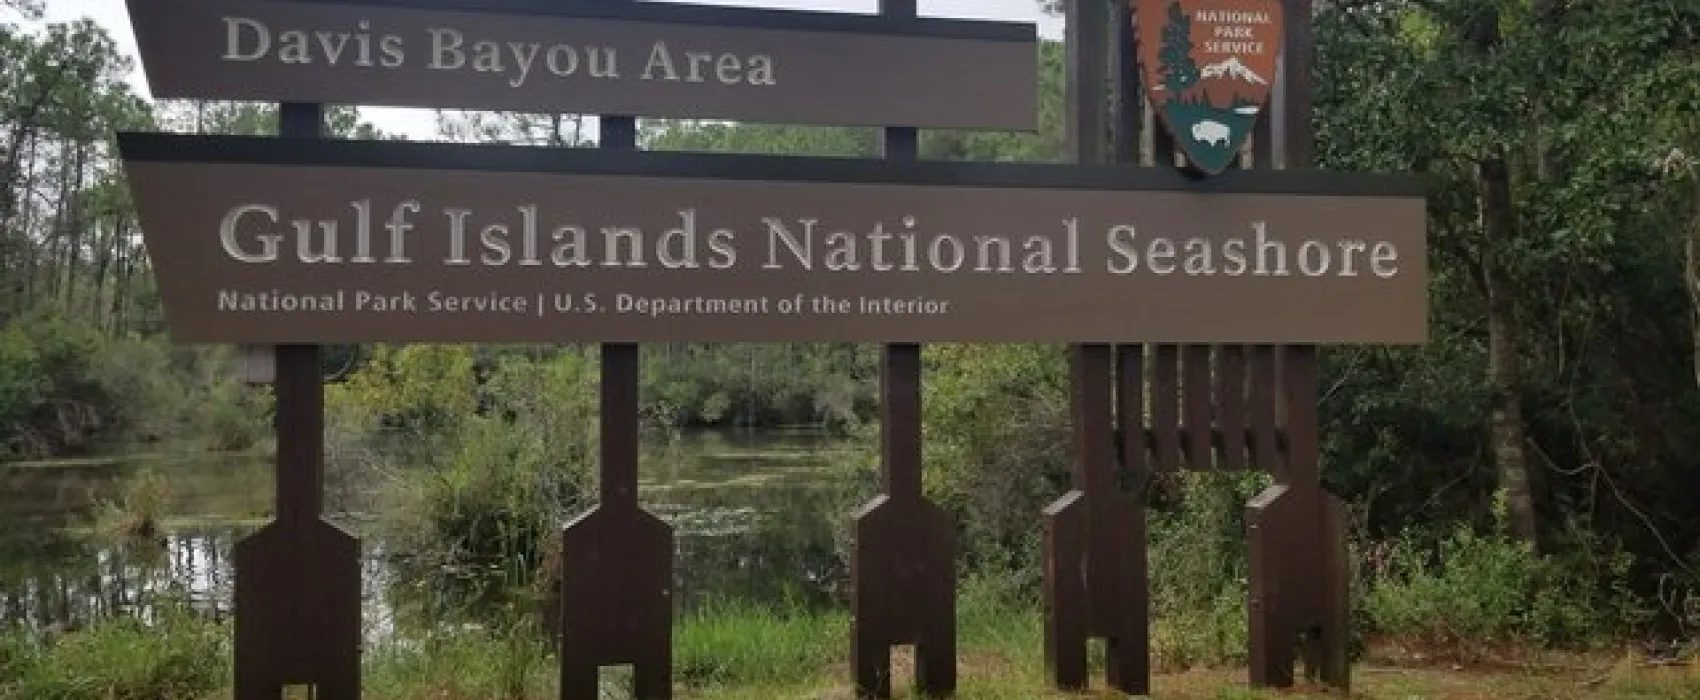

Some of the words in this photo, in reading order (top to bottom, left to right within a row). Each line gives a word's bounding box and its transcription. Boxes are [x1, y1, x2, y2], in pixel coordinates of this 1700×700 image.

[1195, 9, 1272, 23] NATIONAL
[1214, 25, 1254, 38] PARK
[219, 17, 404, 68] Davis
[426, 28, 619, 89] Bayou
[640, 41, 777, 86] Area
[1205, 41, 1265, 54] SERVICE
[218, 199, 421, 265] Gulf
[443, 203, 737, 270] Islands
[760, 216, 1083, 275] National
[1105, 222, 1400, 279] Seashore
[217, 289, 345, 313] National
[355, 291, 416, 313] Park
[428, 291, 527, 314] Service
[554, 294, 605, 314] U.S.
[616, 293, 769, 319] Department
[777, 294, 803, 316] of
[811, 294, 851, 316] the
[859, 295, 949, 317] Interior
